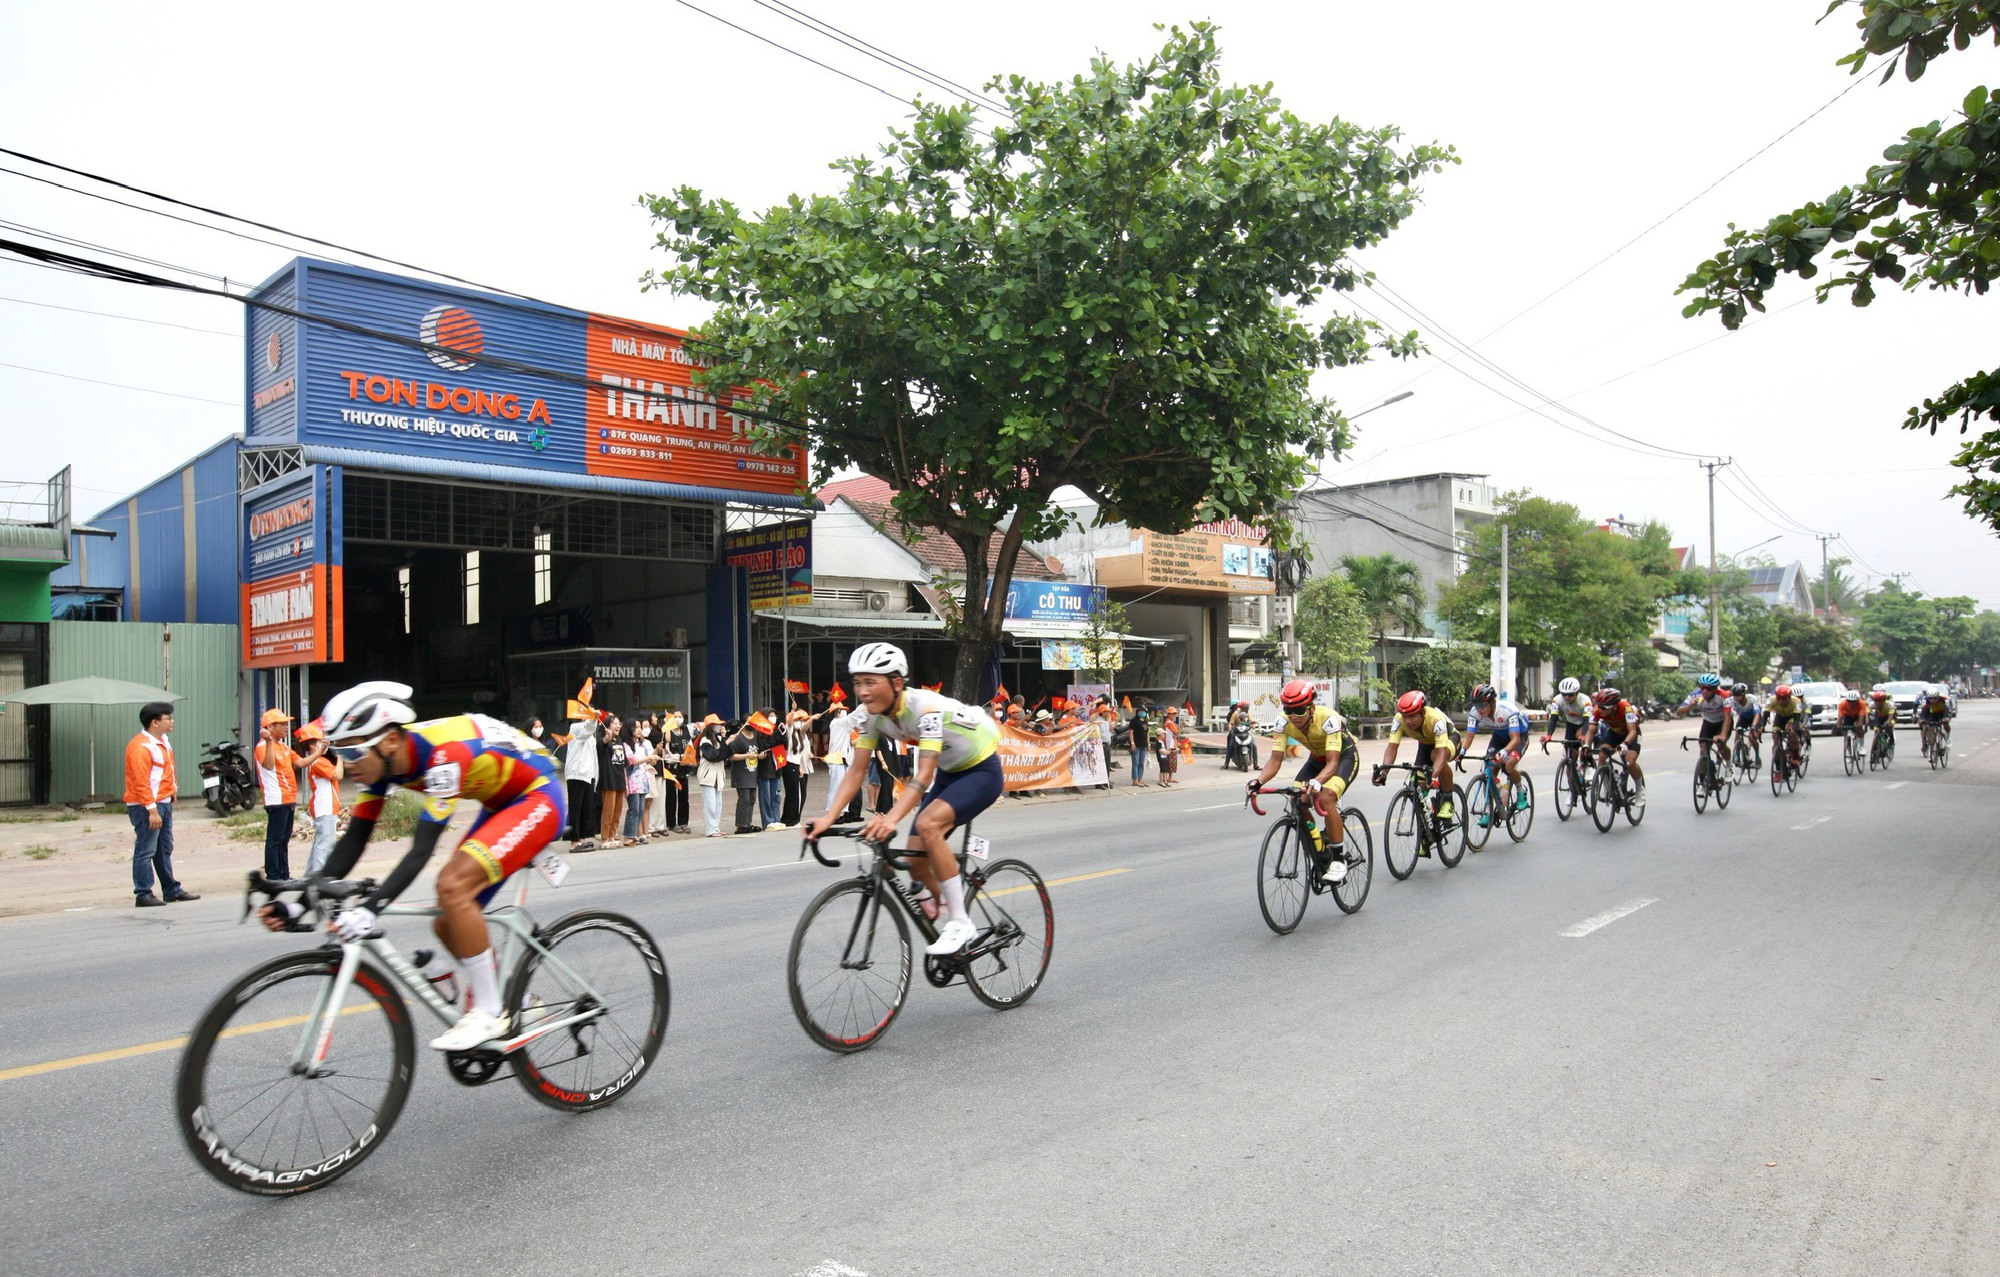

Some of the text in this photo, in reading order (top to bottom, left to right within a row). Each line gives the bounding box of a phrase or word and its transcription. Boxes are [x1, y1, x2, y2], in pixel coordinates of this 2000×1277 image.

[612, 337, 637, 358] NHÀ
[641, 342, 666, 364] MÁY
[340, 370, 552, 425] TON DONG A
[602, 374, 717, 431] THANH
[341, 409, 519, 443] THƯƠNG HIỆU QUỐC GIA
[610, 430, 627, 440] 876
[630, 432, 661, 444] QUANG
[666, 435, 696, 450] TRUNG,
[698, 440, 711, 449] AN
[713, 441, 732, 454] PHÚ,
[733, 445, 746, 455] AN
[610, 446, 637, 457] 02693
[640, 448, 656, 459] 833
[658, 451, 672, 461] 811
[746, 461, 765, 471] 0978
[766, 463, 780, 473] 142
[781, 465, 796, 475] 225
[776, 542, 805, 570] HẢO
[251, 571, 314, 628] THANH HẢO
[1039, 592, 1082, 611] CÔ THU
[594, 664, 682, 678] THANH HẢO GL
[924, 716, 940, 732] 25
[1327, 720, 1334, 729] 4
[1000, 750, 1056, 767] THANH HẢO
[588, 1055, 646, 1102] BORA
